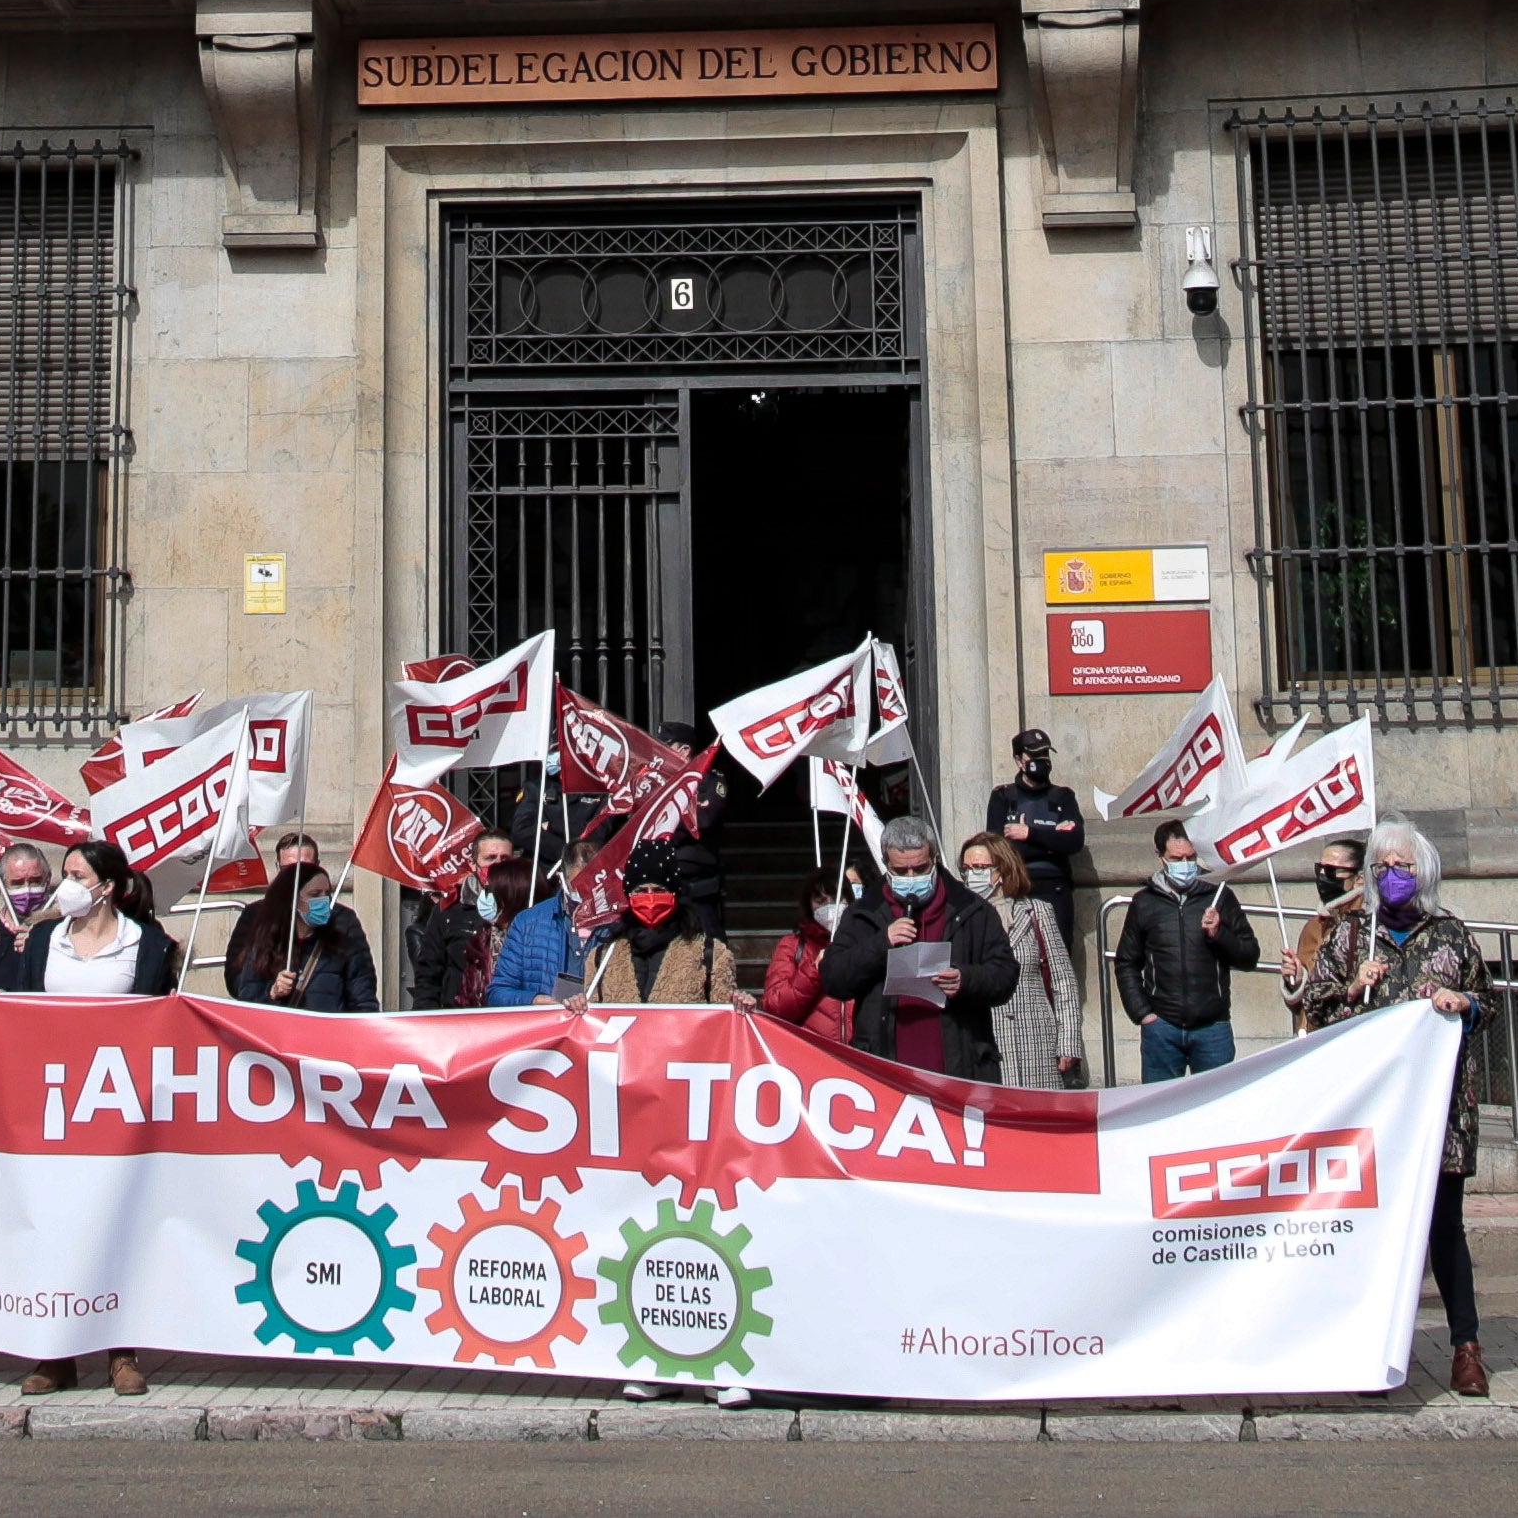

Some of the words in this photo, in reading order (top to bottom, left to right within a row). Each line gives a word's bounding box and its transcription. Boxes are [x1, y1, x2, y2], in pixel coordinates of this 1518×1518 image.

[362, 48, 684, 88] SUBDELEGACION
[697, 46, 778, 80] DEL
[790, 40, 993, 77] GOBIERNO
[674, 281, 691, 307] 6
[1072, 633, 1094, 647] 060
[1072, 666, 1105, 676] OFICINA
[1106, 665, 1148, 674] INTEGRADA
[1073, 677, 1084, 685] DE
[1084, 674, 1123, 685] ATENCIÓN
[1123, 676, 1134, 684] AL
[1134, 675, 1181, 683] CIUDADANO
[42, 1045, 449, 1141] ¡AHORA
[486, 1015, 638, 1159] SÍ
[666, 1061, 986, 1168] TOCA!
[1164, 1144, 1363, 1205] CCOO
[1152, 1222, 1267, 1244] comisiones
[1273, 1217, 1355, 1236] obreras
[1151, 1247, 1177, 1265] de
[1183, 1242, 1258, 1263] Castilla
[1264, 1245, 1277, 1263] y
[1282, 1238, 1336, 1258] León
[305, 1262, 342, 1286] SMI
[468, 1258, 548, 1282] REFORMA
[645, 1258, 721, 1282] REFORMA
[468, 1285, 546, 1309] LABORAL
[655, 1284, 676, 1303] DE
[680, 1285, 712, 1305] LAS
[640, 1308, 729, 1331] PENSIONES
[900, 1326, 1105, 1357] #AhoraSíToca
